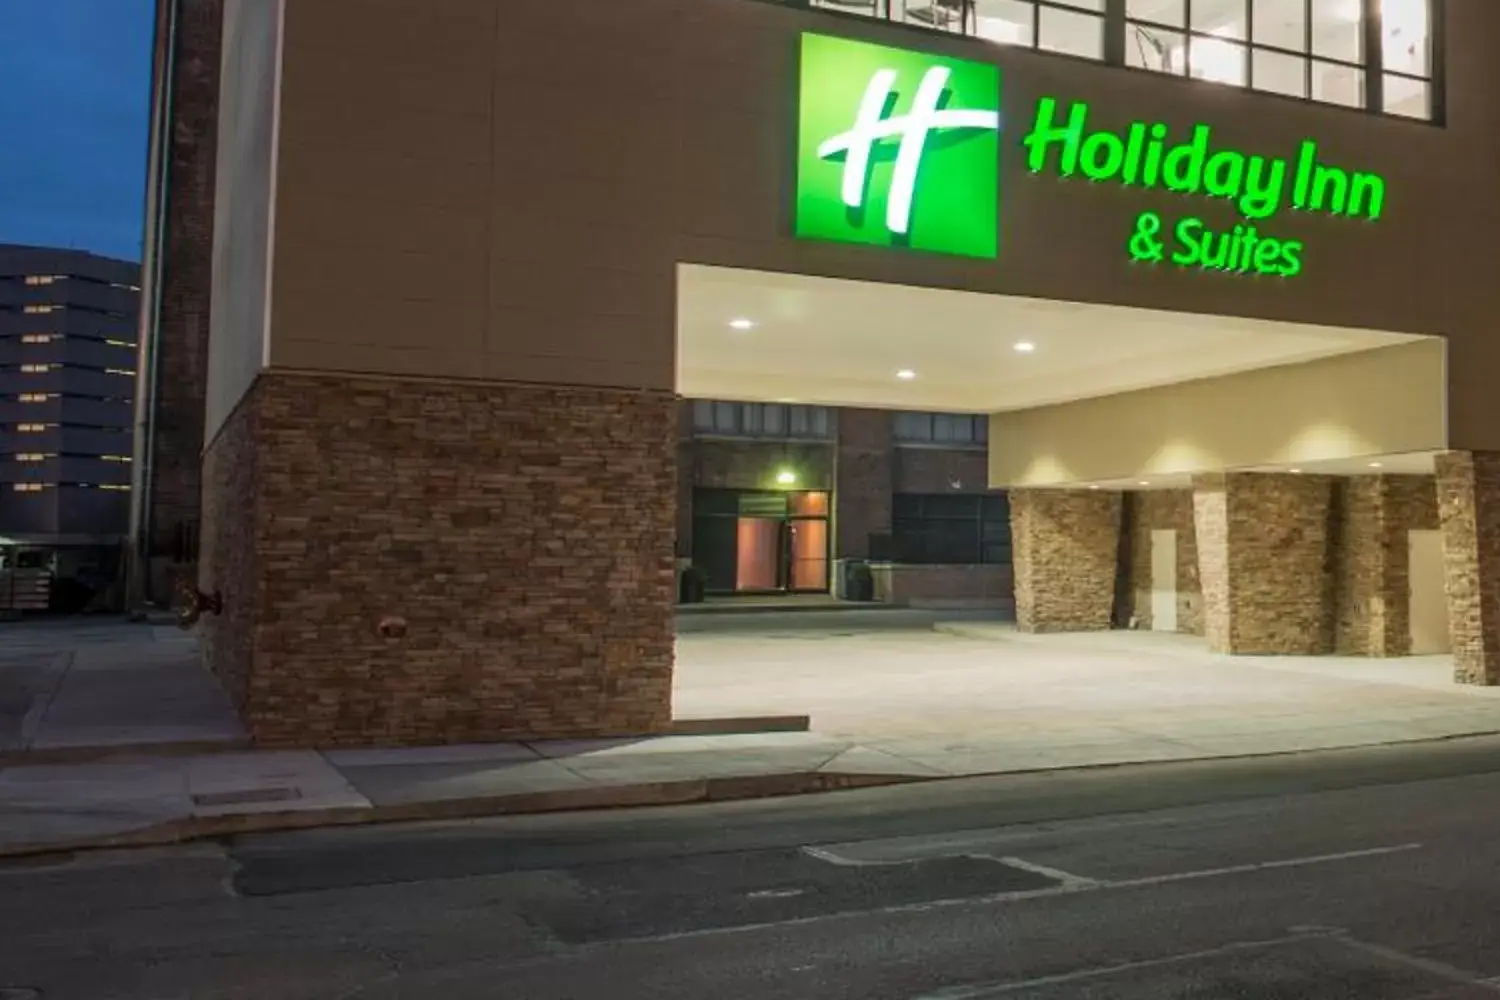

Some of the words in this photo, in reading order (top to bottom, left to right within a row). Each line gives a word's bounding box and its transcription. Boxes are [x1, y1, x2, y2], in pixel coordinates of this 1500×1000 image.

[1023, 97, 1286, 219] Holiday
[1292, 140, 1386, 220] Inn
[1128, 211, 1164, 262] &
[1171, 217, 1303, 277] Suites
